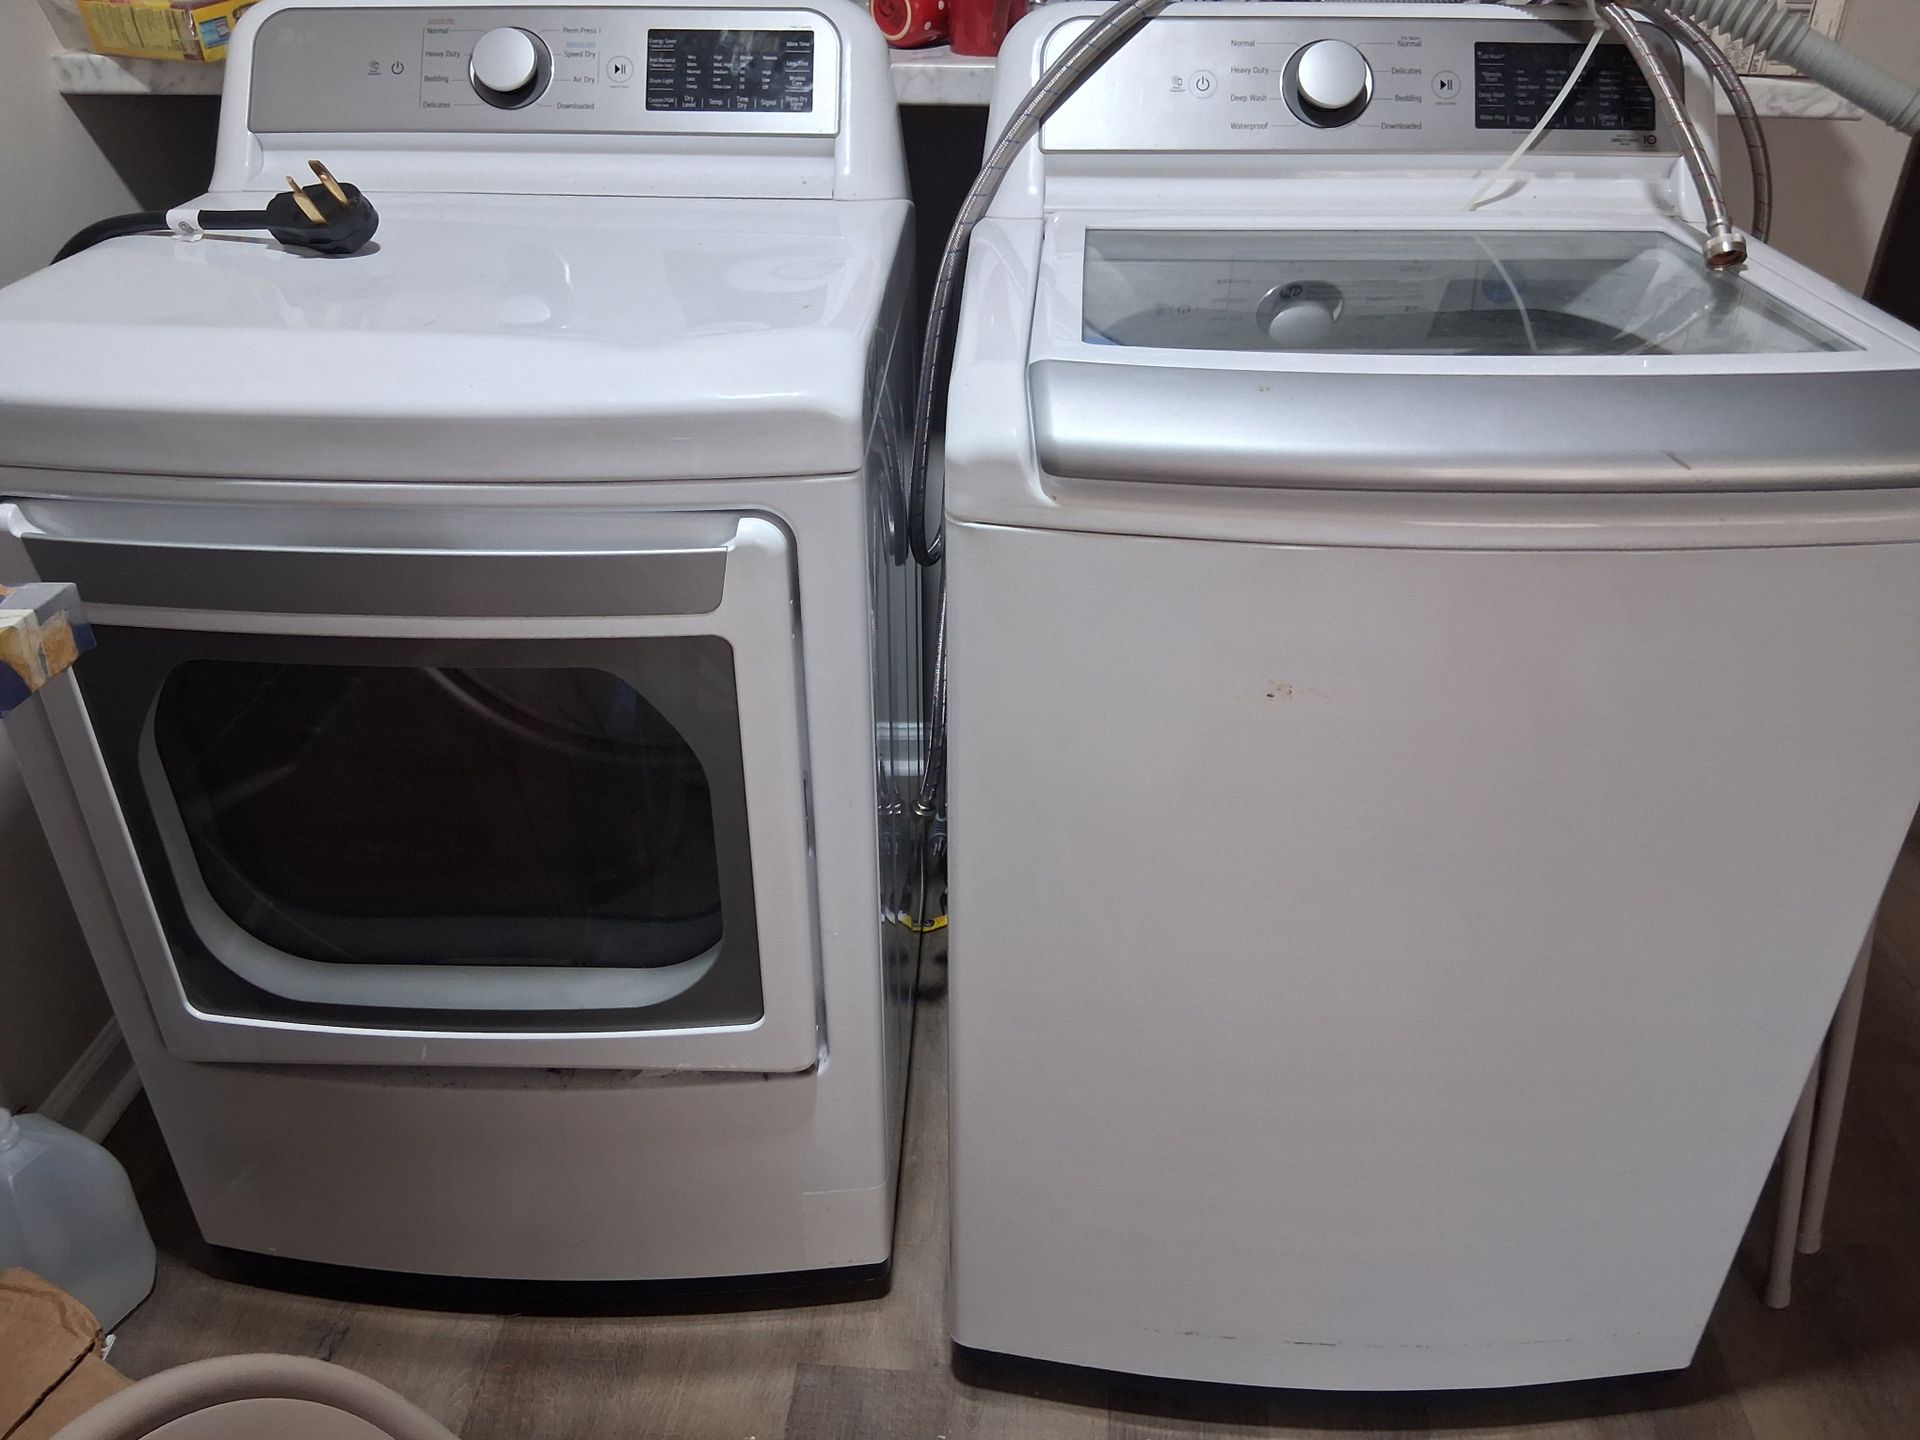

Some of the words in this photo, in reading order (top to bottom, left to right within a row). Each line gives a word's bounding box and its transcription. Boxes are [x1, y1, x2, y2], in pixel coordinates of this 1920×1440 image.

[1397, 40, 1422, 48] Normal
[425, 50, 444, 58] Heavy
[445, 50, 460, 58] Duty
[564, 51, 583, 59] Speed
[585, 51, 596, 59] Dry
[1230, 66, 1251, 75] Heavy
[1253, 66, 1269, 75] Duty
[1391, 67, 1422, 75] Delicates
[1395, 94, 1422, 103] Bedding
[1230, 122, 1269, 131] Waterproof
[1380, 122, 1422, 130] Downloaded
